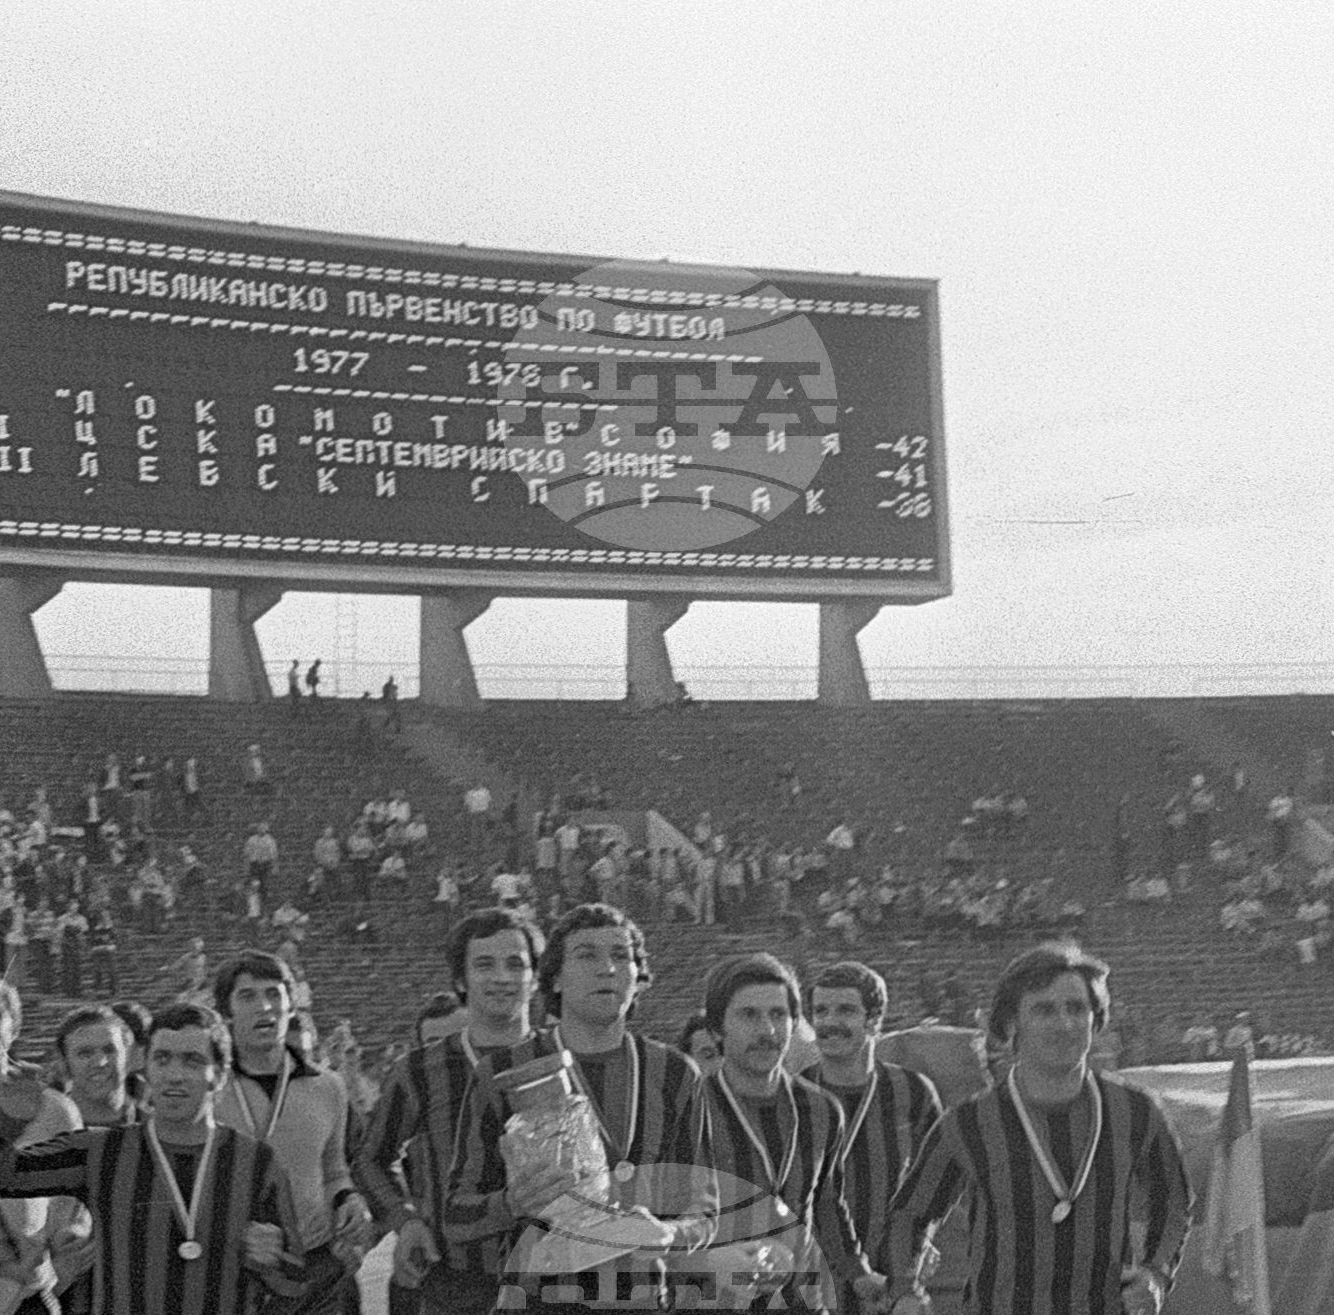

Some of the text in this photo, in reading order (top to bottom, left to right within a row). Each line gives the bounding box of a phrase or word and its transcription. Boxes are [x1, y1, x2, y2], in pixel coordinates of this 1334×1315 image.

[65, 260, 328, 313] РЕПУБЛИКАНСКО
[346, 289, 539, 330] ПЪРВЕНСТВО
[556, 307, 596, 333] ПО
[292, 347, 369, 377] 1977
[467, 360, 542, 388] 1978
